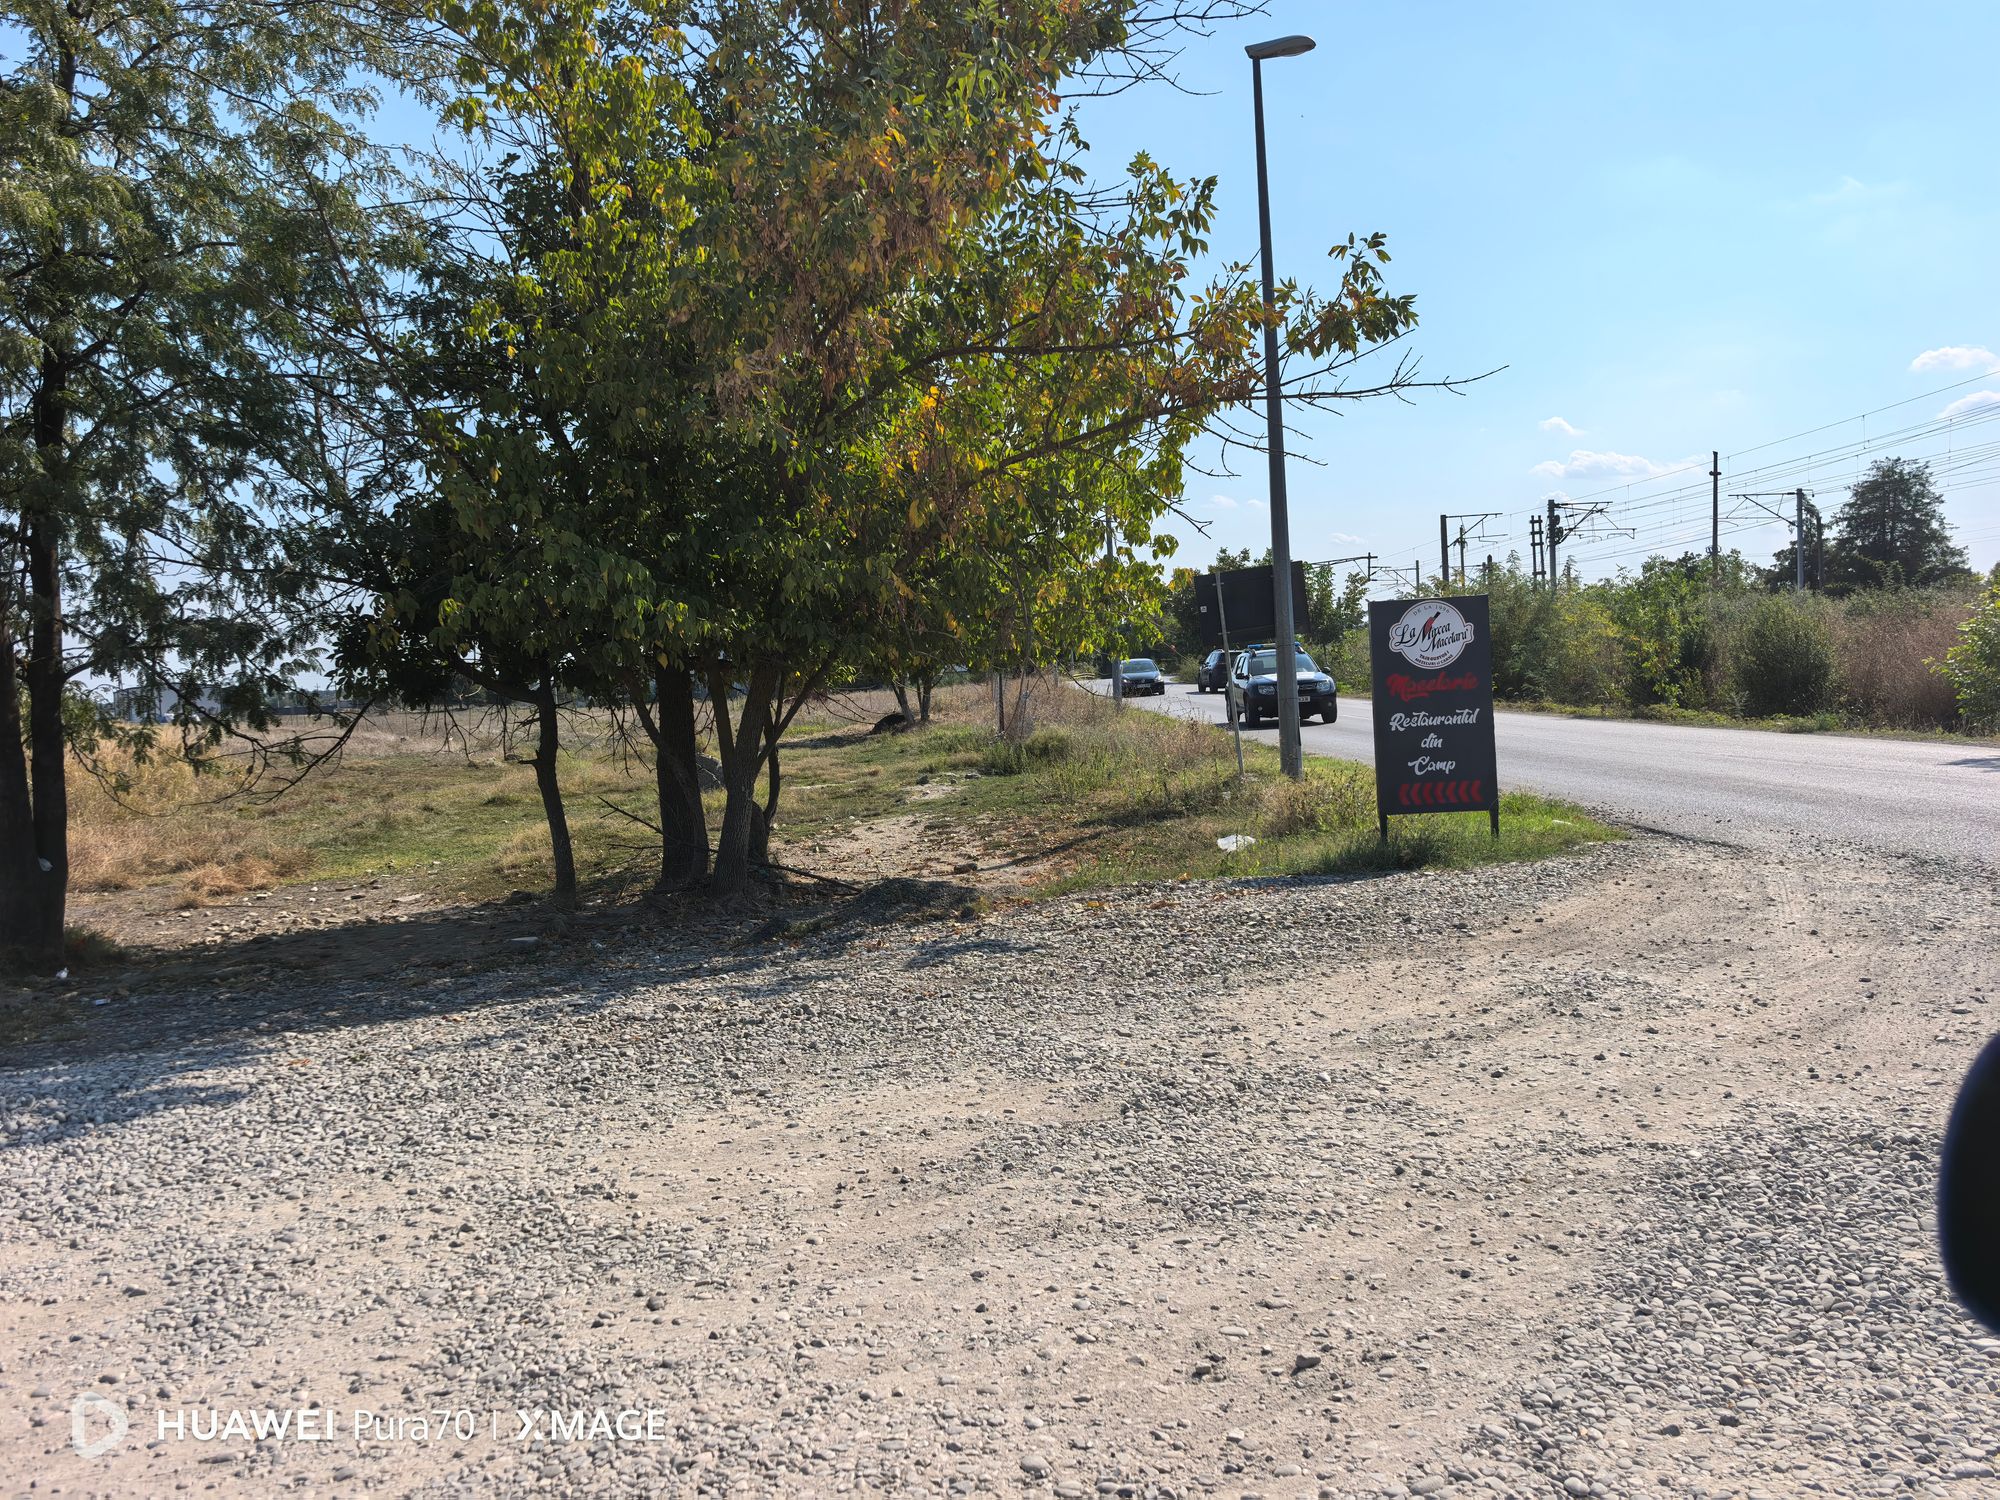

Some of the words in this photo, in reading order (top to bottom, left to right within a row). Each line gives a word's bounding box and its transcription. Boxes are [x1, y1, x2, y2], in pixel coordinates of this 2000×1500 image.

[1394, 623, 1416, 647] La
[1389, 708, 1480, 732] Restaurantul
[1421, 732, 1443, 748] din
[1407, 755, 1456, 776] Camp
